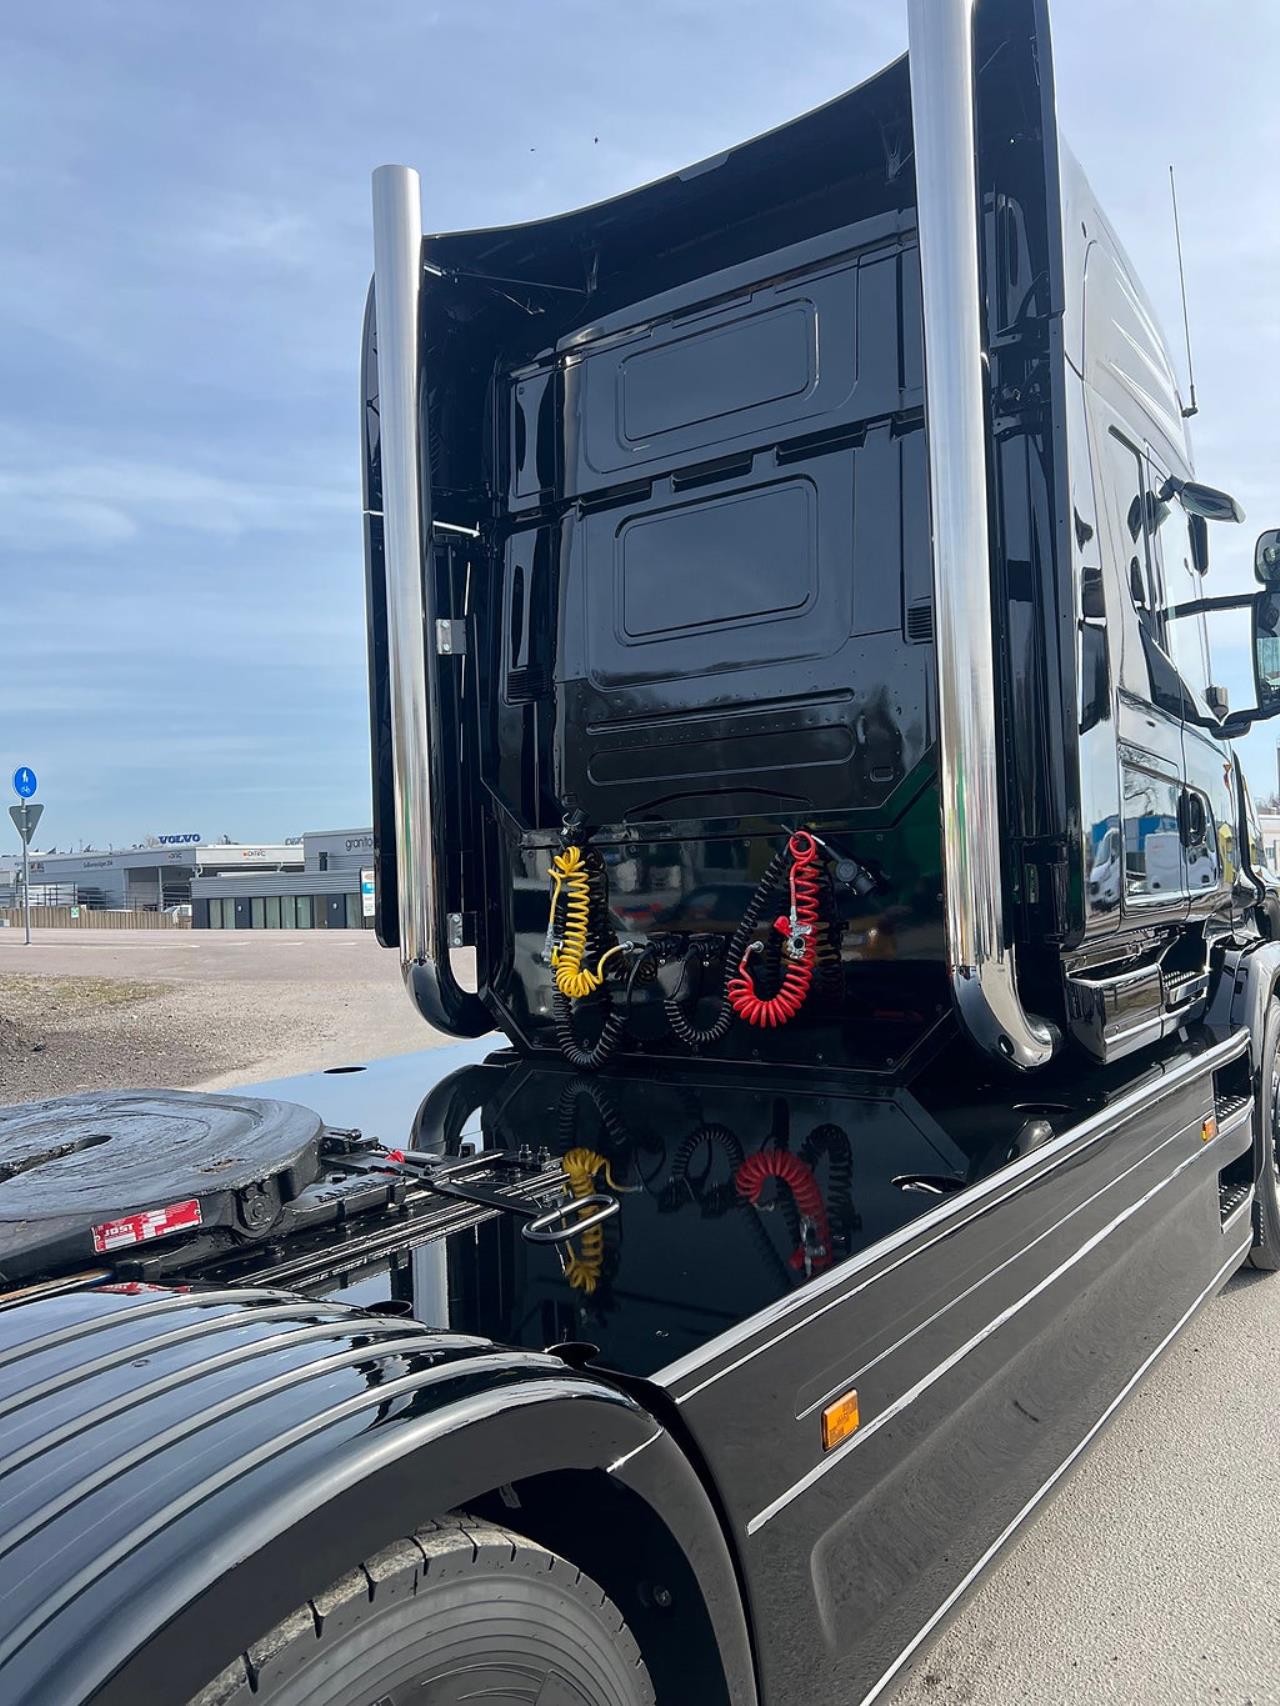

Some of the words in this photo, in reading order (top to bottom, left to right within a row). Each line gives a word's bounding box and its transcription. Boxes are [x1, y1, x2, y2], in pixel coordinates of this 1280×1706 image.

[158, 833, 200, 844] VOLVO
[345, 836, 373, 851] granito
[105, 1224, 133, 1236] JOST
